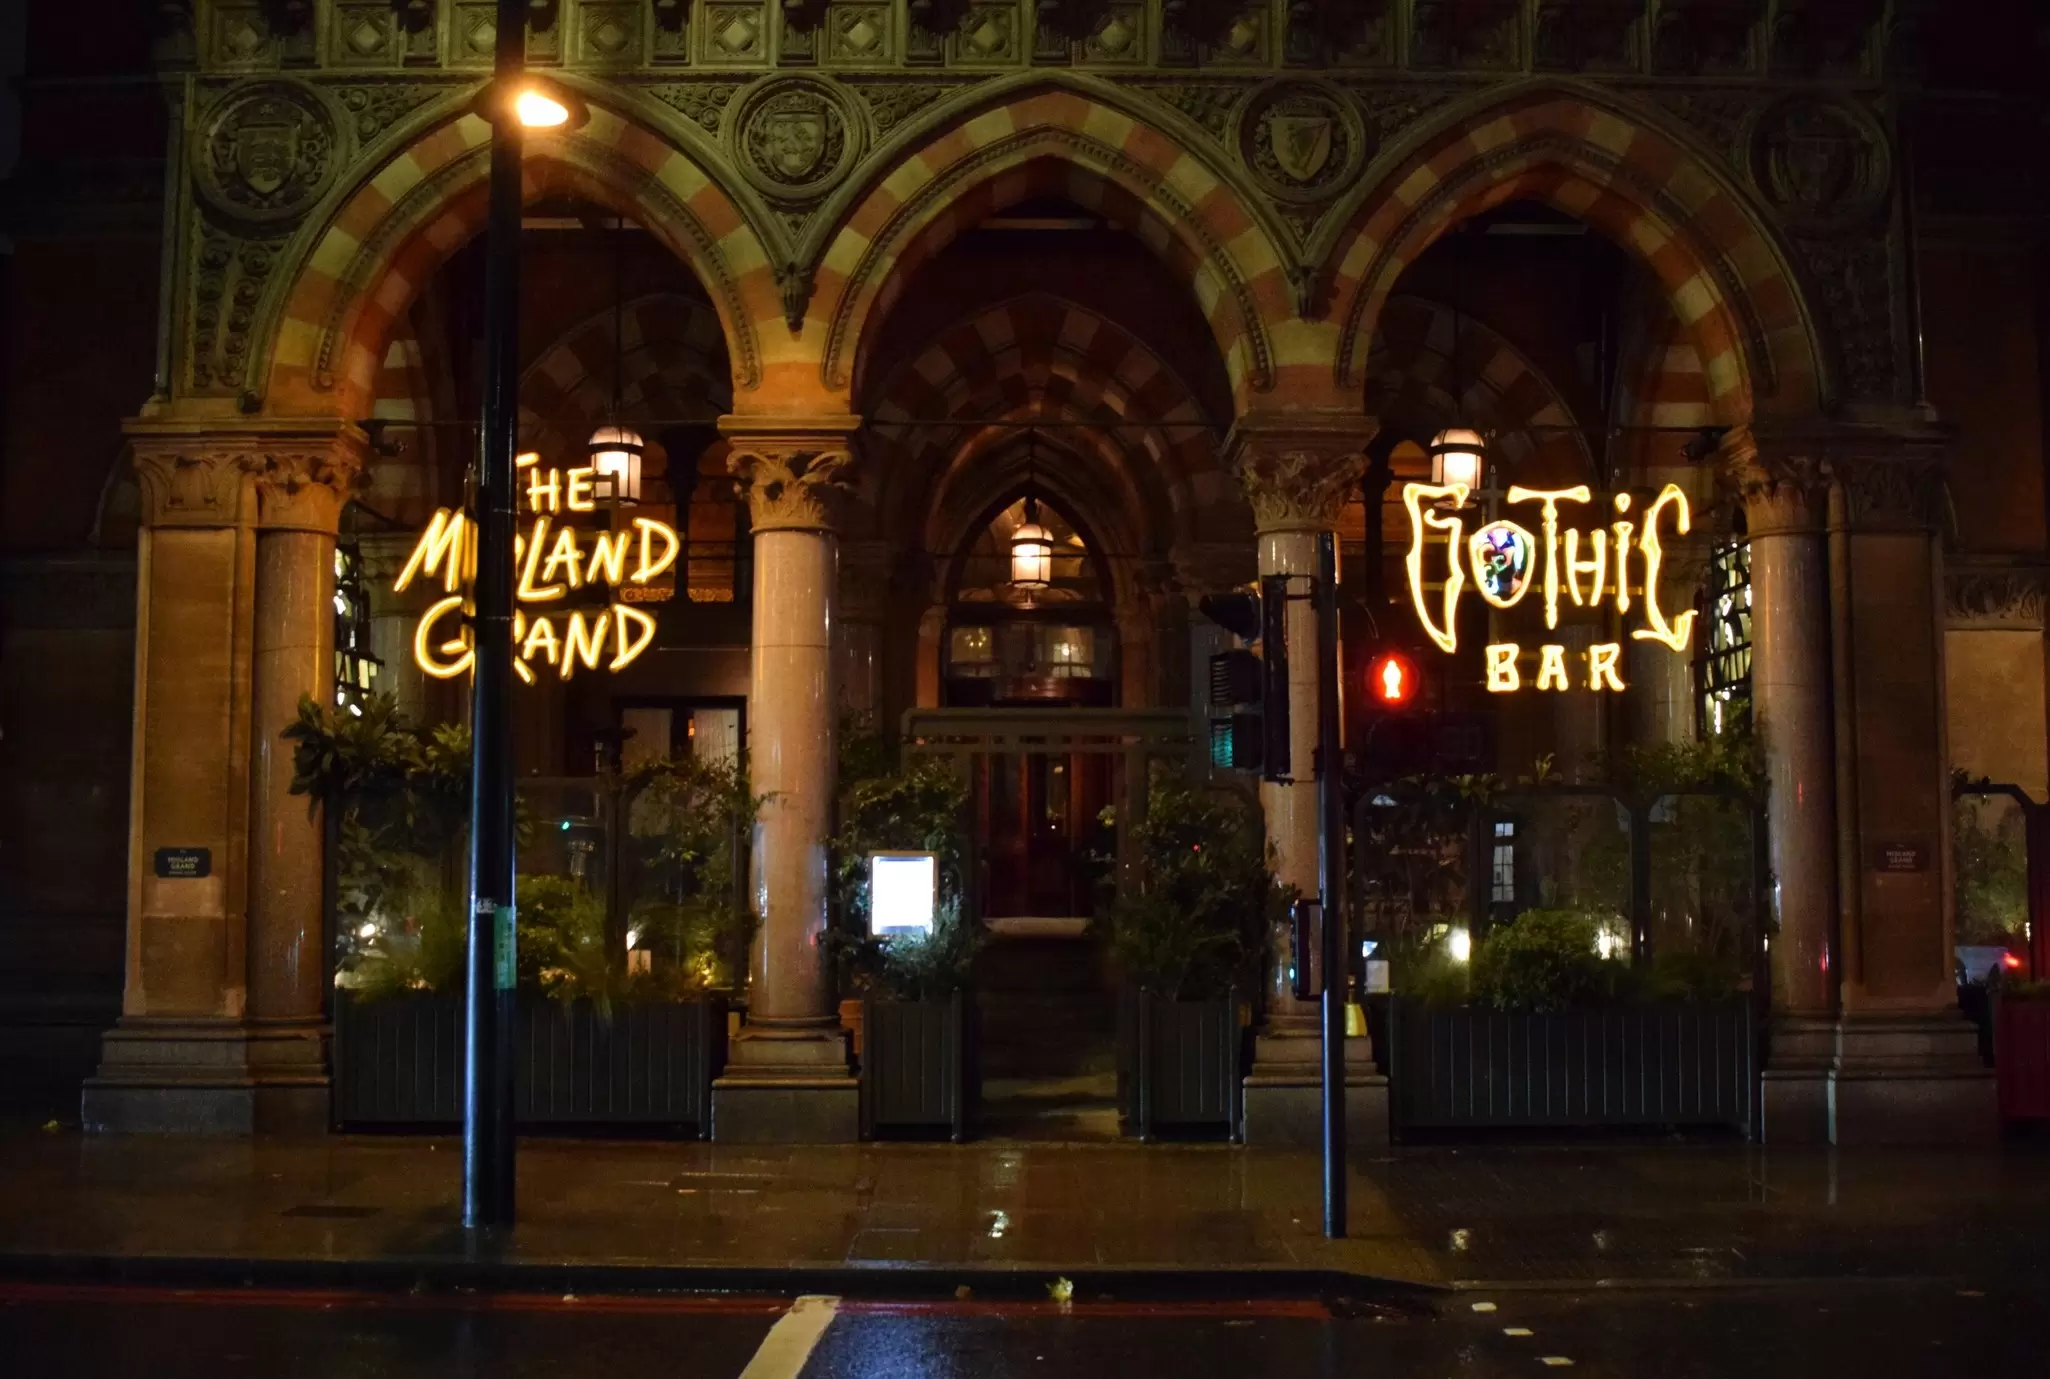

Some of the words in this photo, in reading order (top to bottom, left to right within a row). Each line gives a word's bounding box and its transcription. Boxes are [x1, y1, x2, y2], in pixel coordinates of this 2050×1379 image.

[516, 452, 596, 513] HE
[393, 507, 680, 602] MLAND
[1486, 643, 1625, 692] BAR
